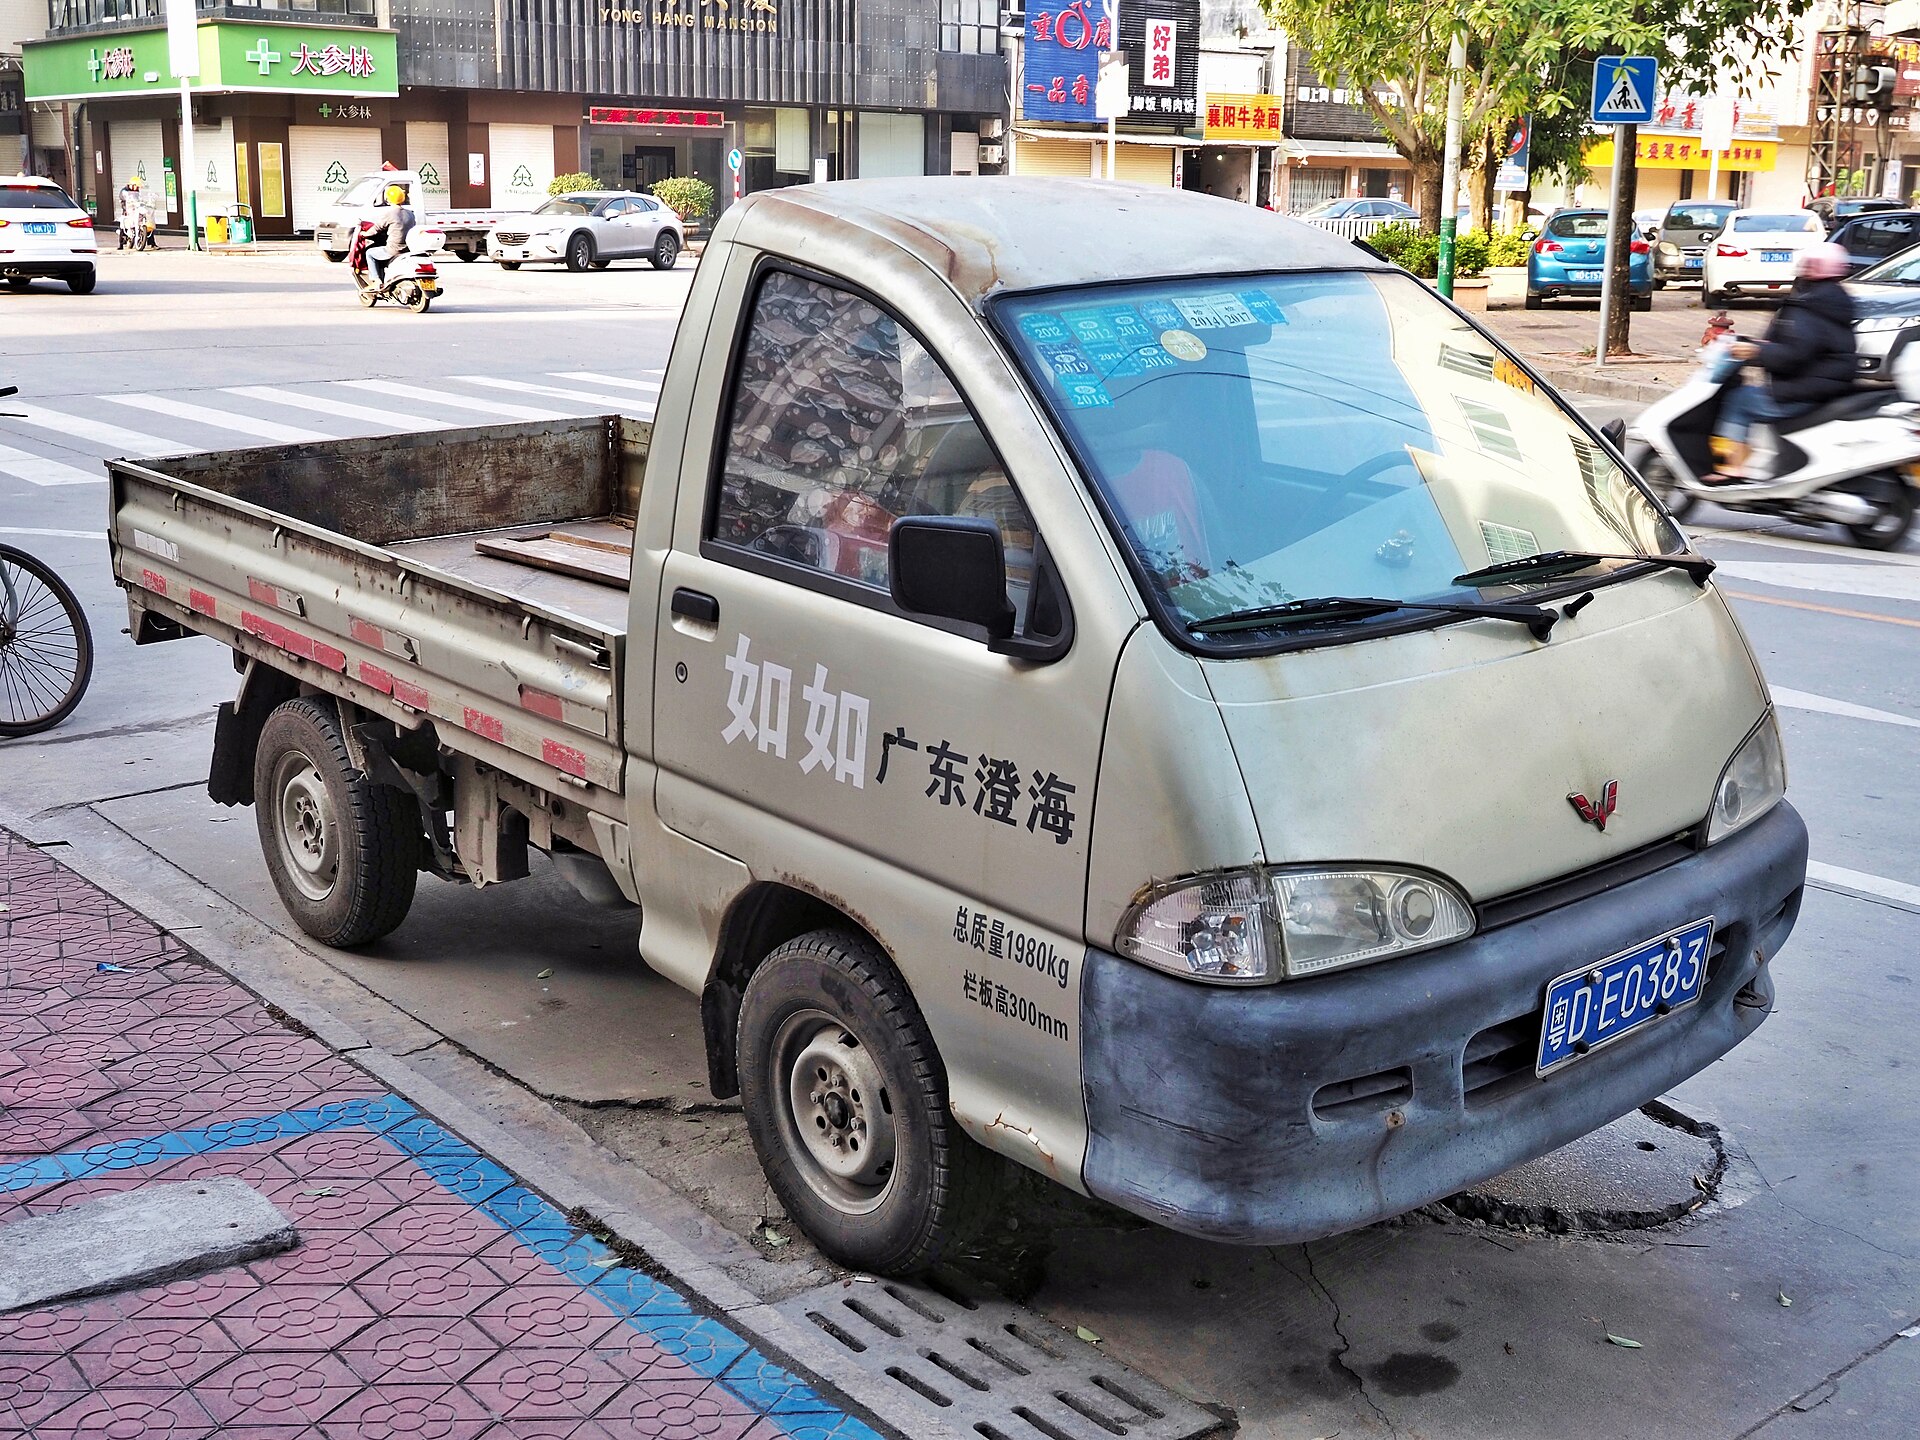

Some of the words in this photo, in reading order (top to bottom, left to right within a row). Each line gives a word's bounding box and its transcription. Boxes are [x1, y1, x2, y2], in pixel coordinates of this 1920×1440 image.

[600, 8, 644, 23] YONG
[652, 11, 696, 27] HANG
[704, 15, 777, 33] MANSION
[1153, 25, 1171, 80] 好弟
[1027, 74, 1090, 106] 一品香
[1128, 96, 1156, 111] 脚饭
[1207, 104, 1281, 130] 襄阳牛杂面
[1191, 316, 1220, 327] 2014
[1224, 312, 1251, 324] 2017
[1034, 326, 1063, 338] 2012
[1079, 328, 1114, 341] 2012
[1116, 323, 1149, 336] 2013
[1054, 361, 1089, 374] 2019
[1140, 355, 1173, 368] 2016
[1073, 393, 1110, 405] 2018
[720, 633, 870, 790] 如如
[876, 727, 1076, 845] 广东澄海
[953, 905, 1070, 989] 总质量1980kg
[963, 969, 1068, 1041] 栏板高300mm
